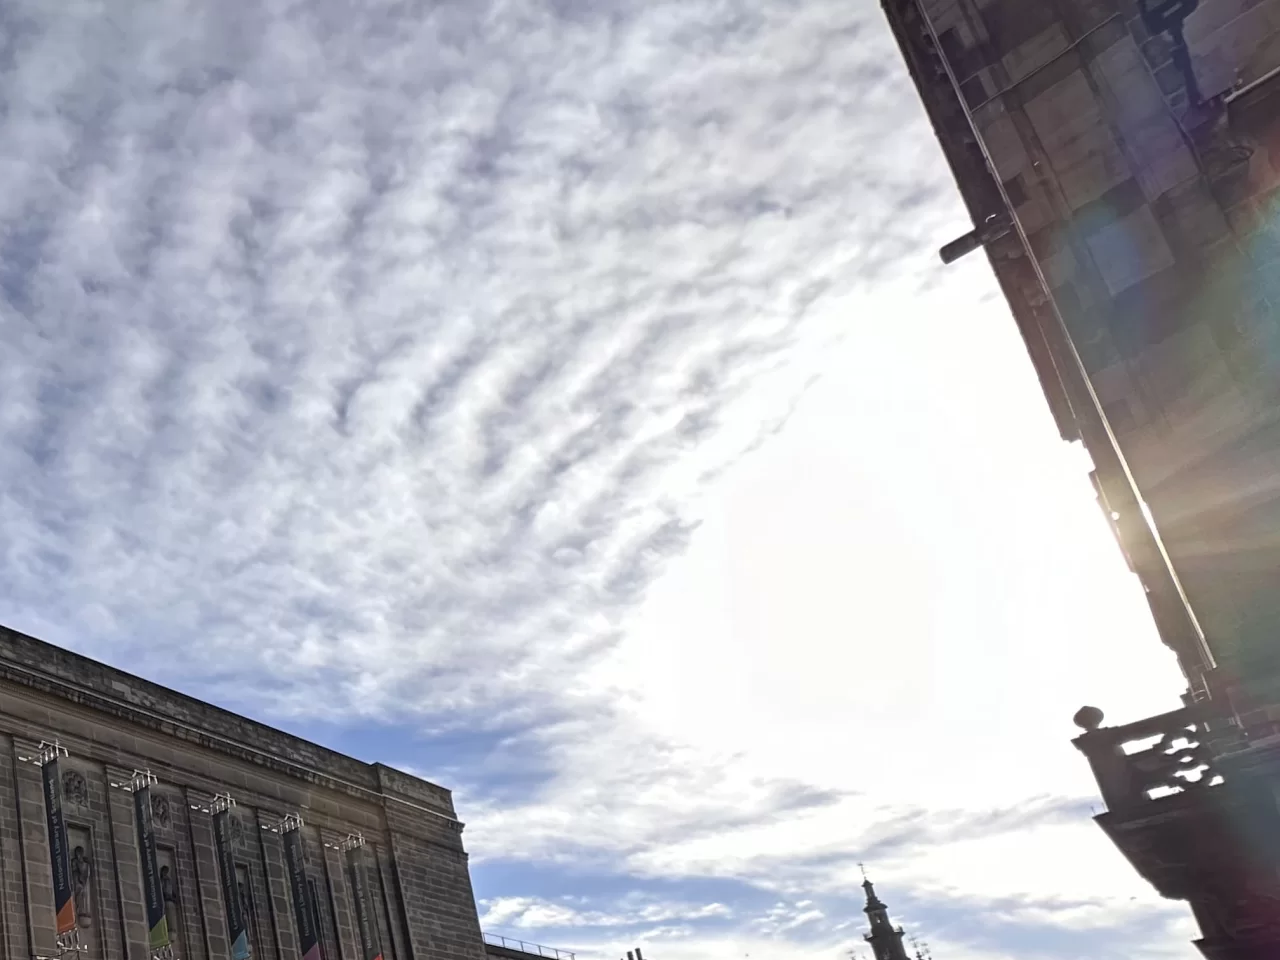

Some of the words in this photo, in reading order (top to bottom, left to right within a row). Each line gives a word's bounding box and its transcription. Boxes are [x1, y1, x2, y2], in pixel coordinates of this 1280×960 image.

[48, 779, 57, 814] Scotland
[53, 826, 61, 854] Library
[56, 855, 65, 891] National
[146, 849, 154, 874] Library
[149, 875, 157, 908] National
